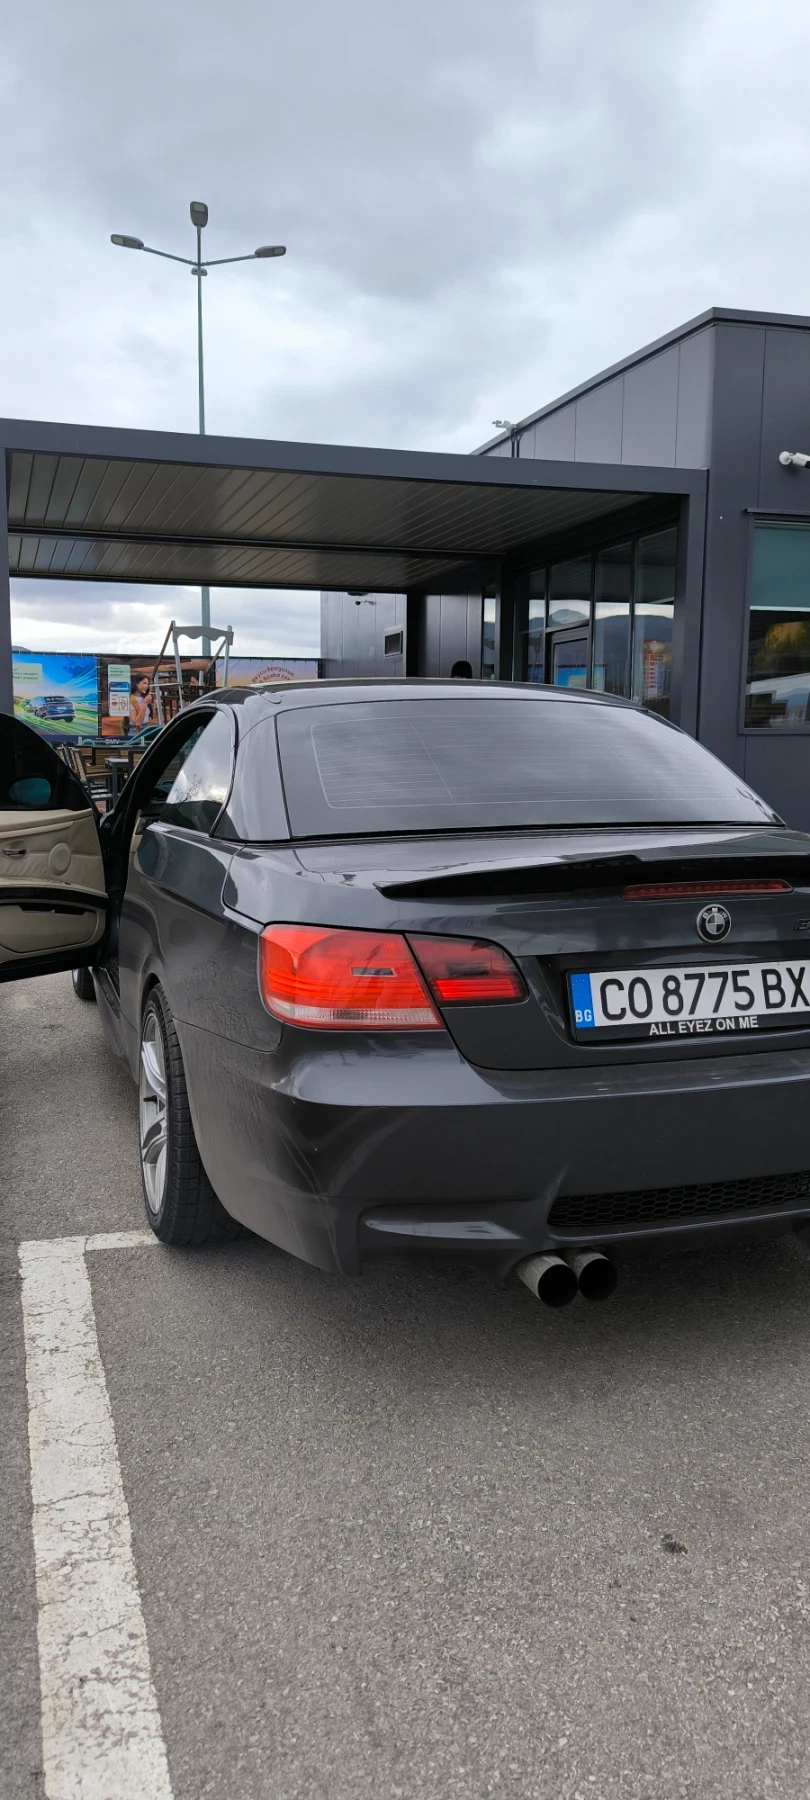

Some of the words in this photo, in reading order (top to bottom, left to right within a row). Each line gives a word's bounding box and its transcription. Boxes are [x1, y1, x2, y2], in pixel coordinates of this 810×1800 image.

[599, 977, 654, 1021] CO
[662, 970, 756, 1016] 8775
[761, 966, 810, 1010] BX
[575, 1009, 593, 1023] BG
[649, 1022, 676, 1036] ALL
[678, 1019, 713, 1034] EYEZ
[715, 1018, 737, 1031] ON
[738, 1016, 759, 1029] ME
